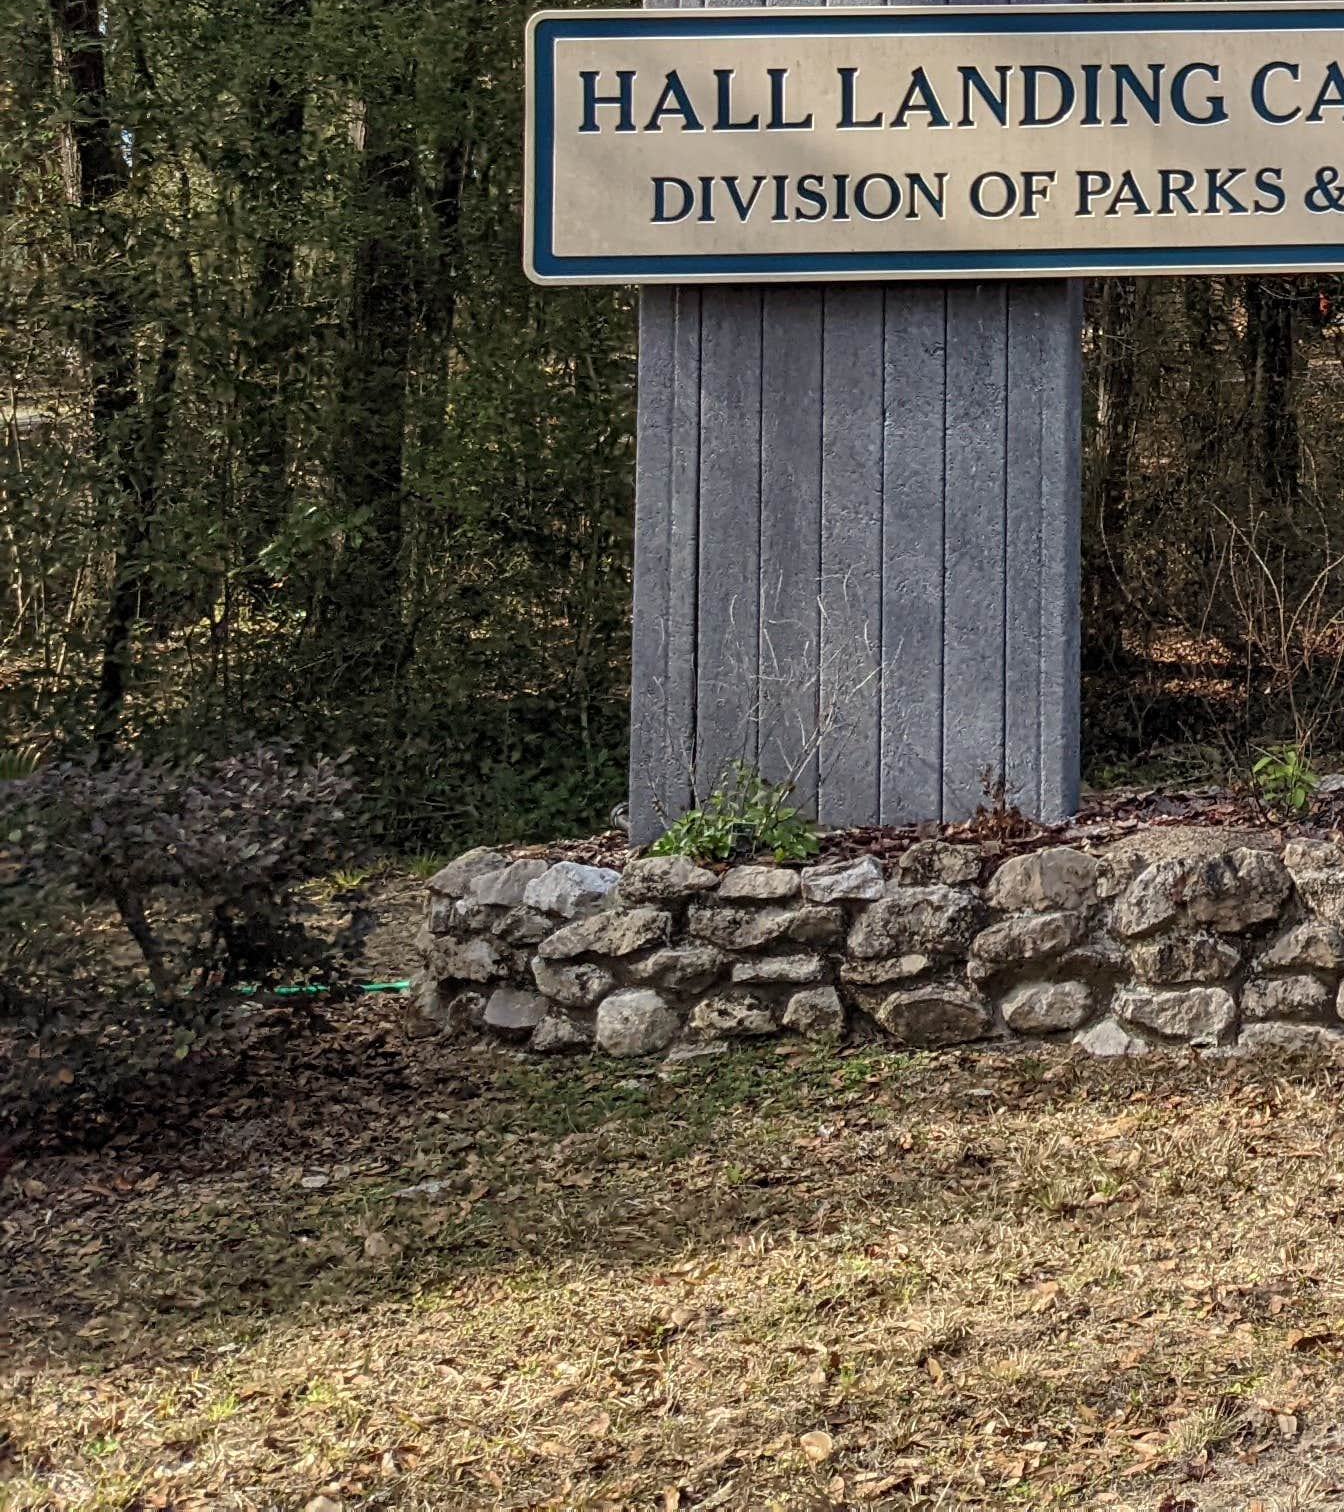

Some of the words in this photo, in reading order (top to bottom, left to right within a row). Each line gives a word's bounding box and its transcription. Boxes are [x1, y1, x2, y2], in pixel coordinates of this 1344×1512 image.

[578, 70, 813, 133] HALL
[836, 63, 1229, 130] LANDING
[650, 172, 949, 224] DIVISION
[969, 170, 1057, 219] OF
[1075, 167, 1288, 217] PARKS
